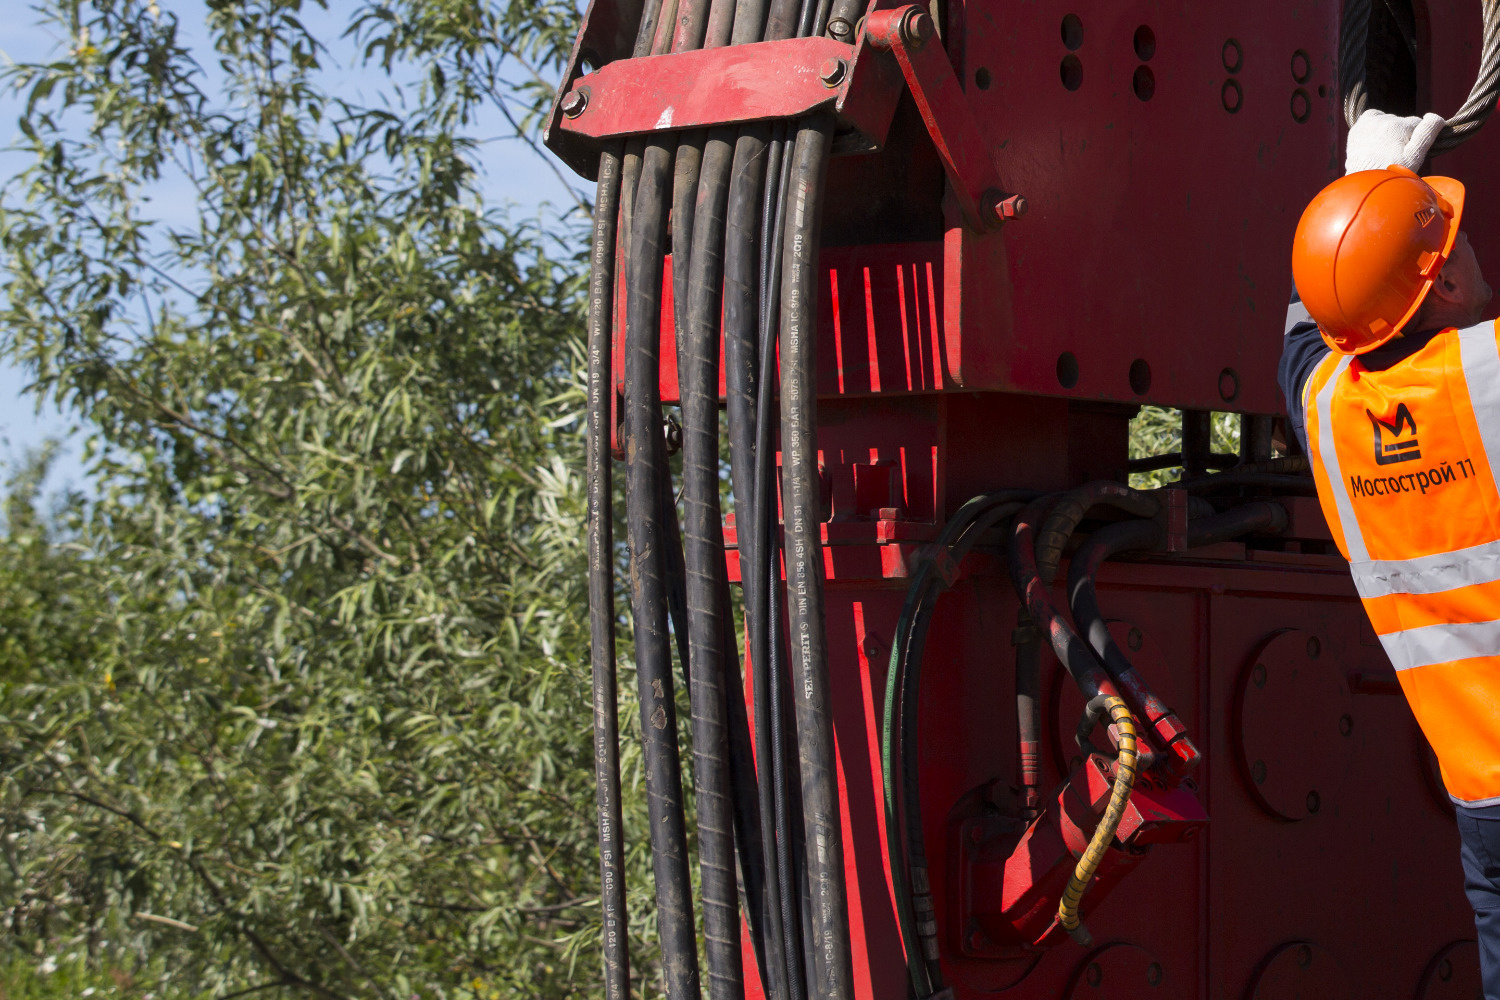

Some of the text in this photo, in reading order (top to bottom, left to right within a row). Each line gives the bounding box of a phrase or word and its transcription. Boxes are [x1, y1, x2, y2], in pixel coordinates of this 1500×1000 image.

[600, 182, 610, 212] MSHA
[597, 220, 606, 237] PSI
[595, 240, 605, 264] 6090
[793, 234, 803, 258] 2Q19
[594, 272, 603, 294] BAR
[790, 289, 800, 322] IC-8/19
[790, 325, 799, 354] MSHA
[592, 344, 600, 365] 3/4"
[592, 372, 600, 384] 19
[790, 378, 799, 401] 5075
[791, 406, 799, 428] BAR
[791, 431, 800, 448] 350
[791, 450, 801, 466] WP
[1350, 458, 1476, 498] Мостострой 11
[793, 505, 802, 516] 31
[794, 518, 803, 533] DN
[795, 539, 804, 559] 4SH
[796, 561, 805, 578] 856
[798, 581, 807, 595] EN
[798, 598, 807, 615] DIN
[603, 850, 612, 868] PSI
[610, 979, 620, 999] 3/4"
